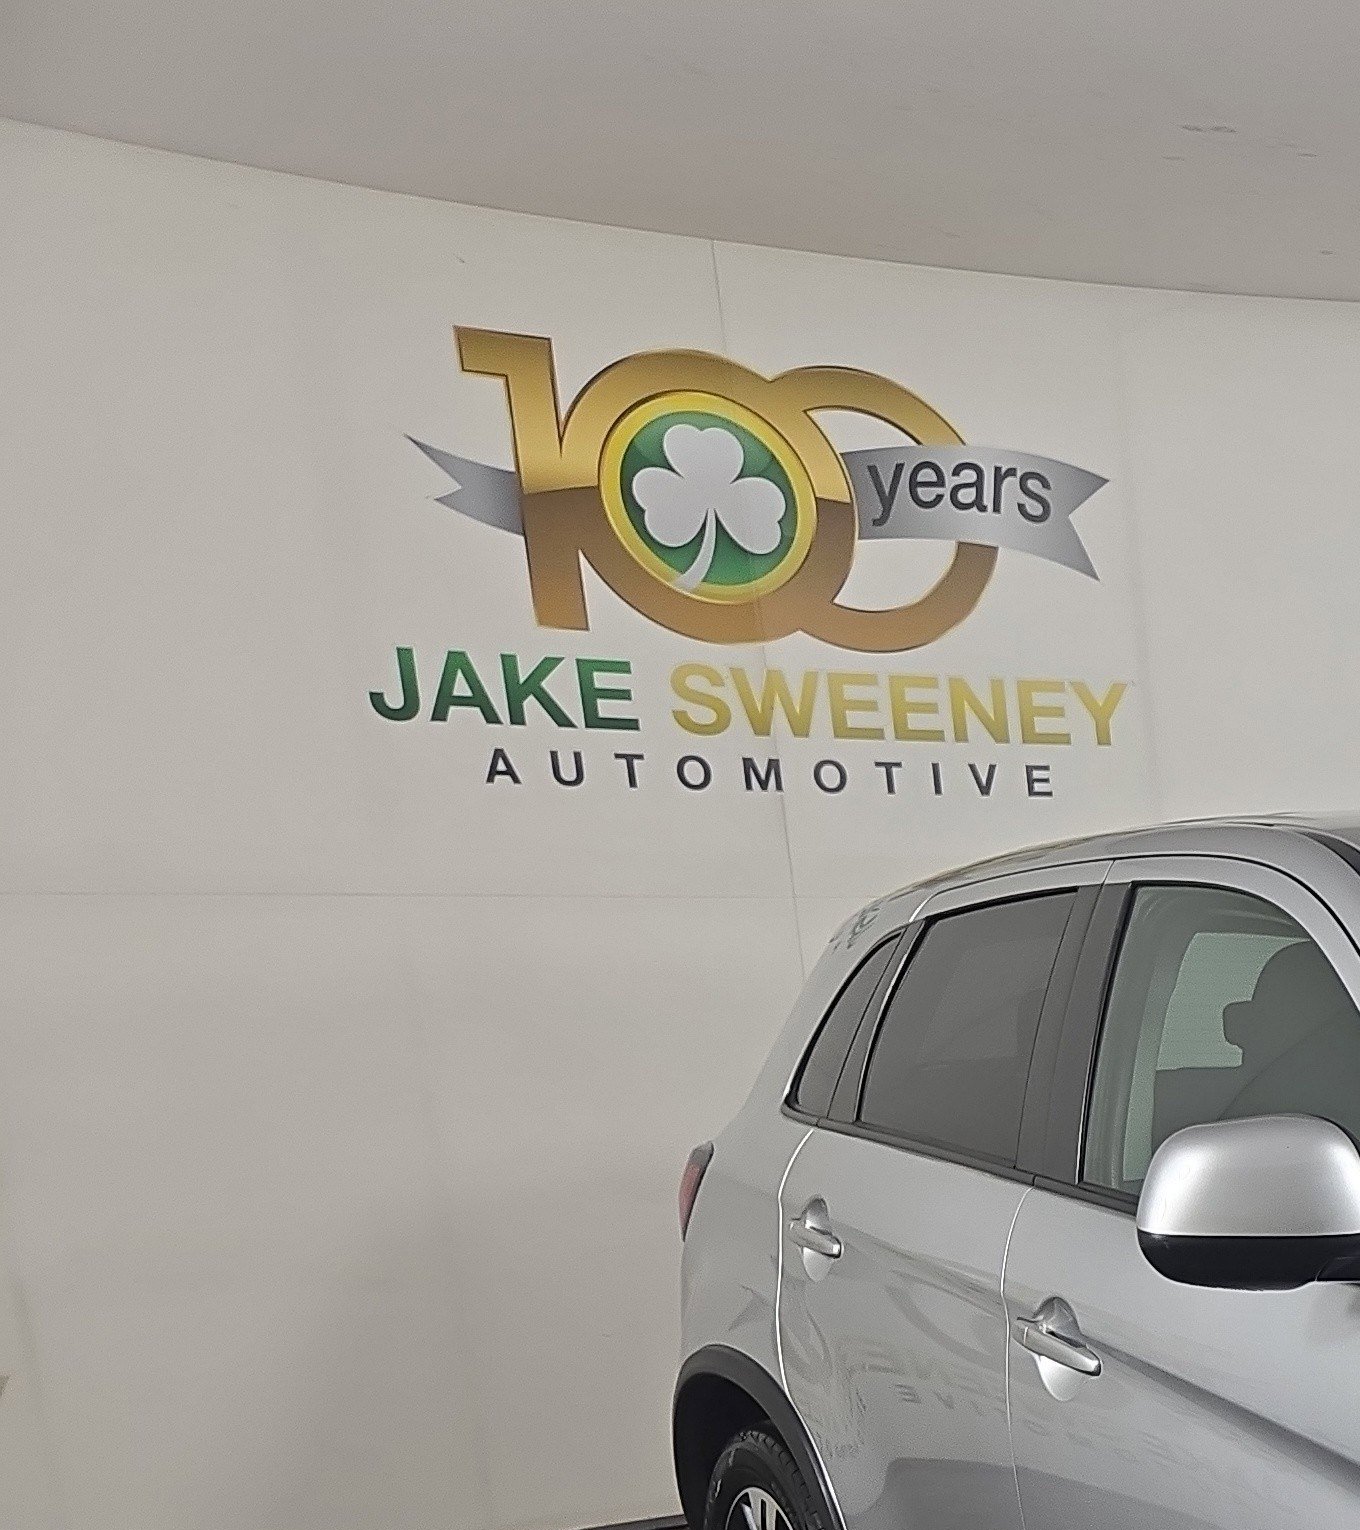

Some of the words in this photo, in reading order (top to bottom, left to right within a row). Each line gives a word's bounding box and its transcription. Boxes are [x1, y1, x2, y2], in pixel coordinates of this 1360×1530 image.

[453, 325, 998, 653] 100
[867, 460, 1052, 528] years
[368, 645, 641, 733] JAKE
[670, 663, 1128, 747] SWEENEY
[486, 748, 1054, 798] AUTOMOTIVE
